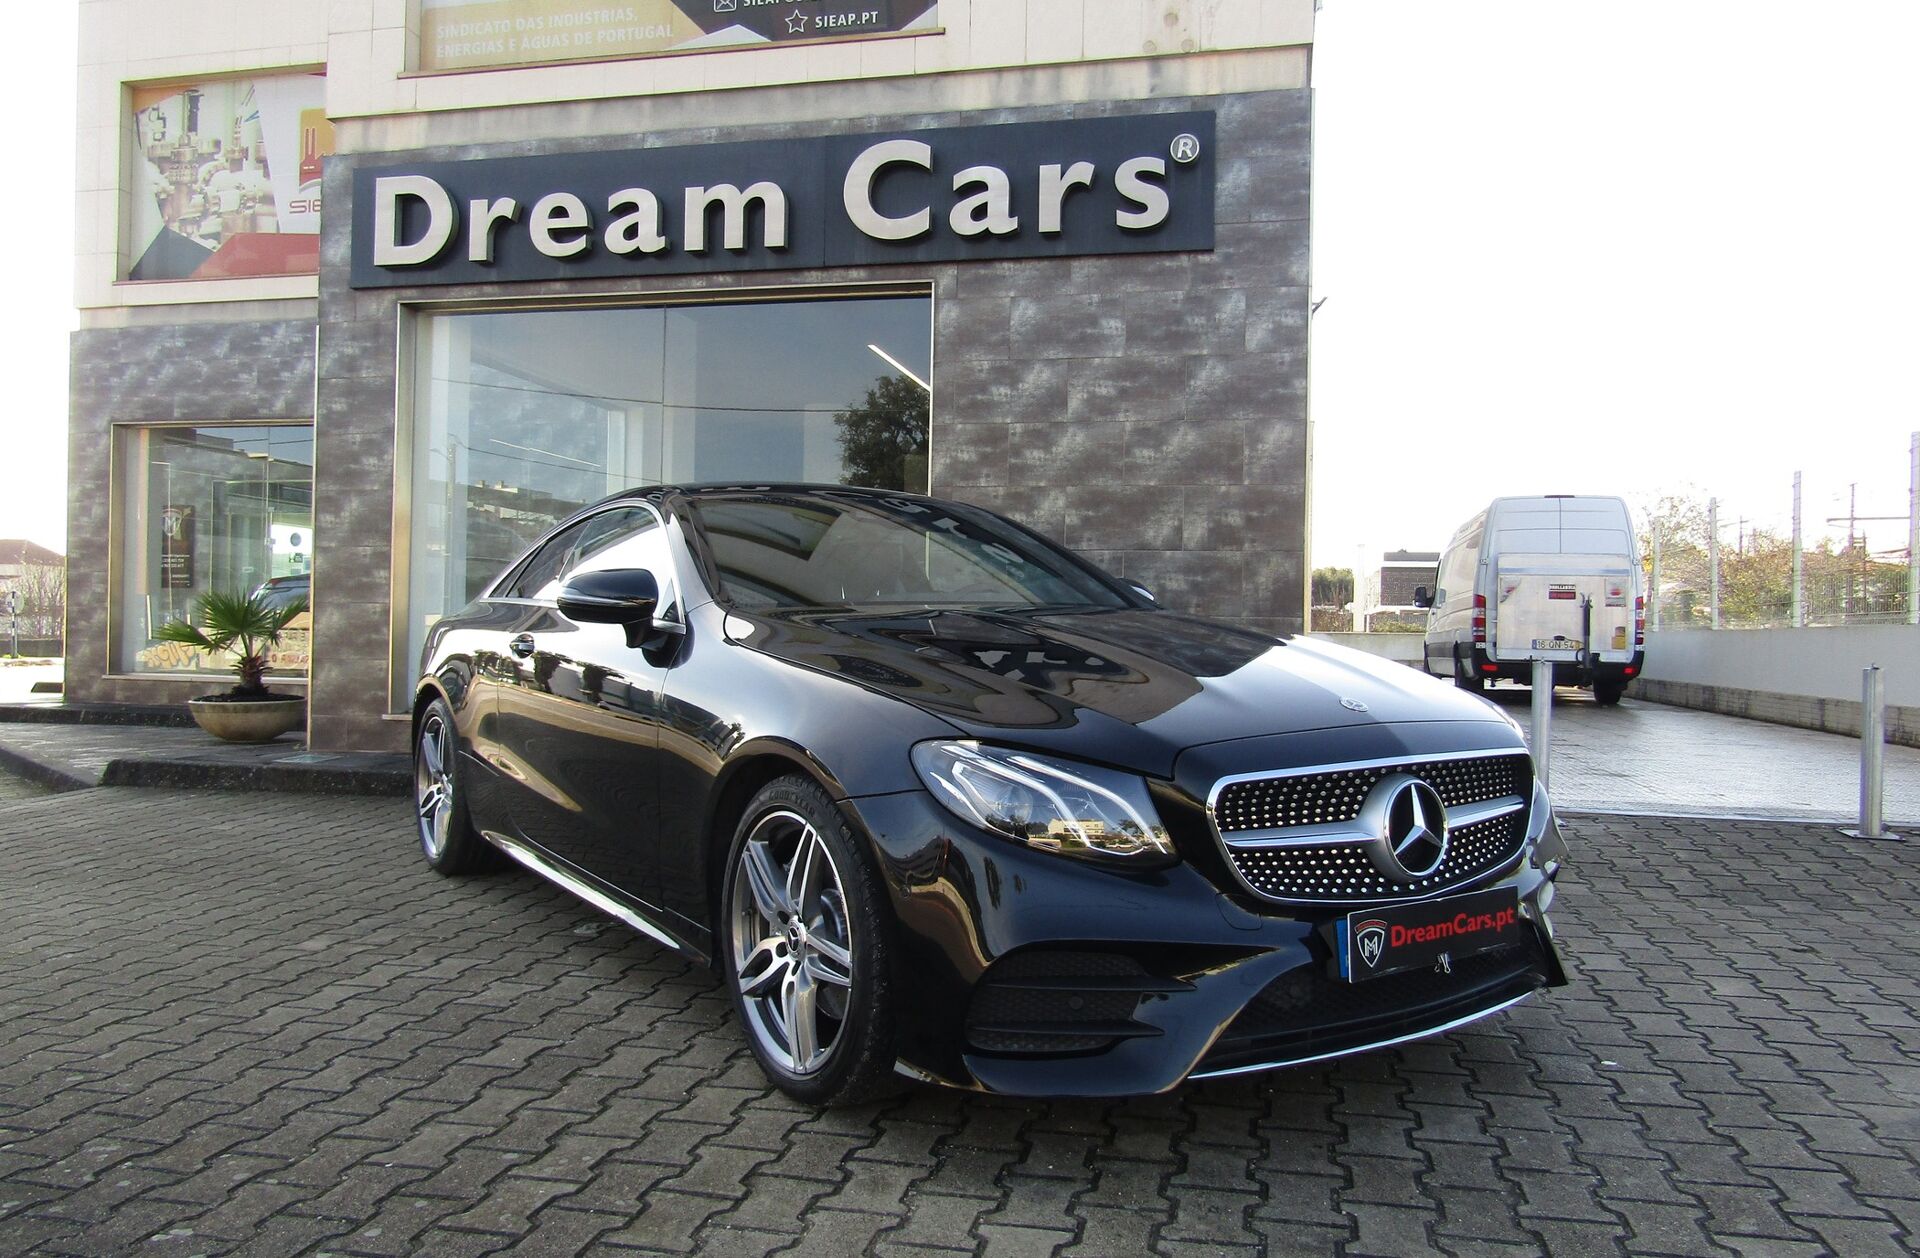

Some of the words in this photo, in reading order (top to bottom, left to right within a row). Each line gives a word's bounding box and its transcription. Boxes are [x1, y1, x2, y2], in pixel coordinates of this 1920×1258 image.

[437, 20, 511, 39] SINDICATO
[516, 17, 544, 31] DAS
[815, 11, 879, 29] SIEAP.PT
[437, 40, 504, 58] ENERGIAS
[509, 39, 516, 50] E
[575, 32, 593, 45] DE
[599, 25, 673, 42] PORTUGAL
[373, 174, 788, 267] Dream
[843, 139, 1172, 242] Cars
[1391, 907, 1514, 947] DreamCars.pt
